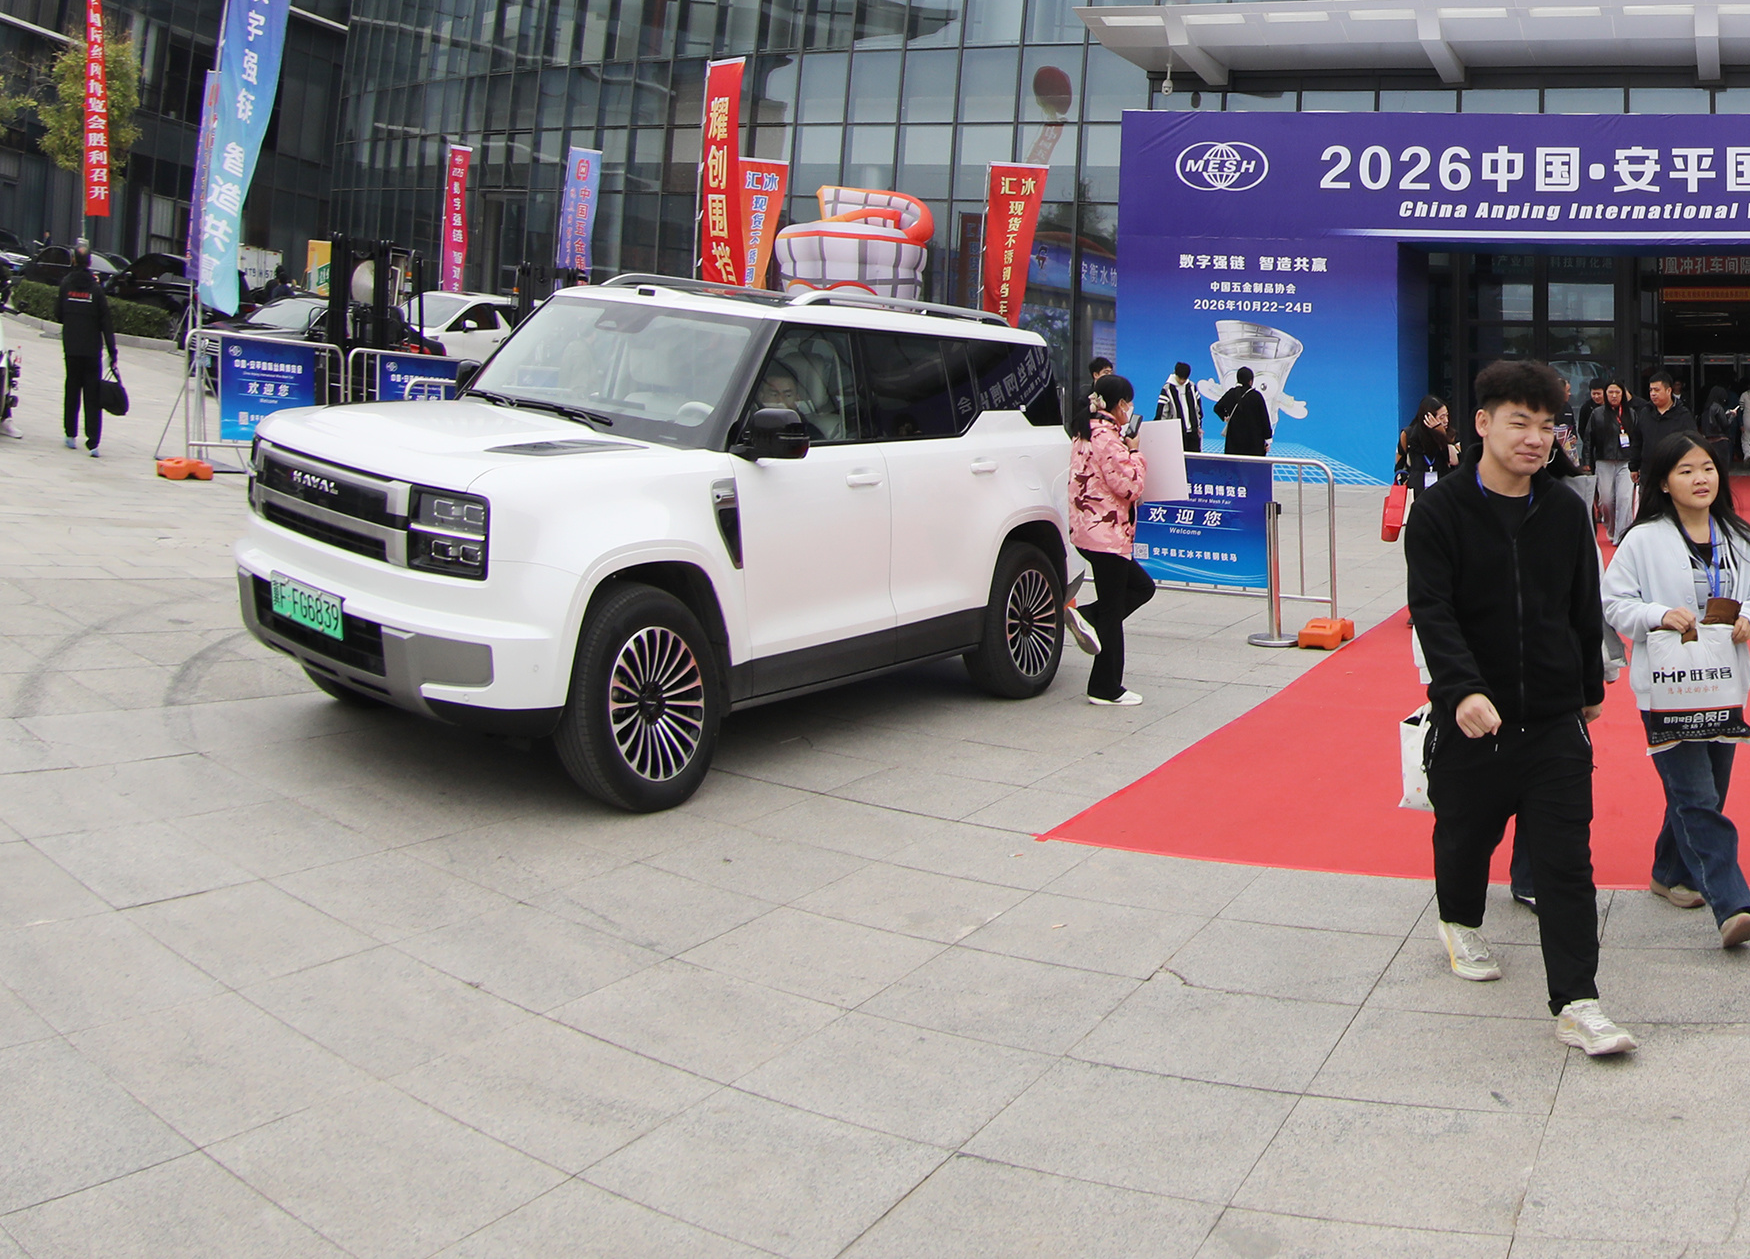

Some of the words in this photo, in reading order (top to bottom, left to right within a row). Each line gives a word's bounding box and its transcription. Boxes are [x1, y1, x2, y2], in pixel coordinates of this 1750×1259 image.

[1185, 159, 1256, 173] MESH
[745, 171, 780, 192] 汇冰
[1000, 176, 1037, 197] 汇冰
[707, 97, 738, 285] 耀创围挡
[1399, 200, 1468, 218] China
[1475, 201, 1561, 221] Anping
[1569, 202, 1738, 220] International
[1179, 253, 1246, 271] 数字强链
[1259, 255, 1328, 273] 智造共赢
[1210, 280, 1297, 294] 中国五金制品协会
[1193, 298, 1313, 314] 2026年10月22-24日
[247, 381, 290, 397] 欢迎您
[1148, 506, 1222, 527] 欢迎您
[1169, 527, 1202, 536] Welcome
[1152, 546, 1238, 563] 安平县汇冰不锈钢铁马
[1653, 669, 1686, 684] PMP
